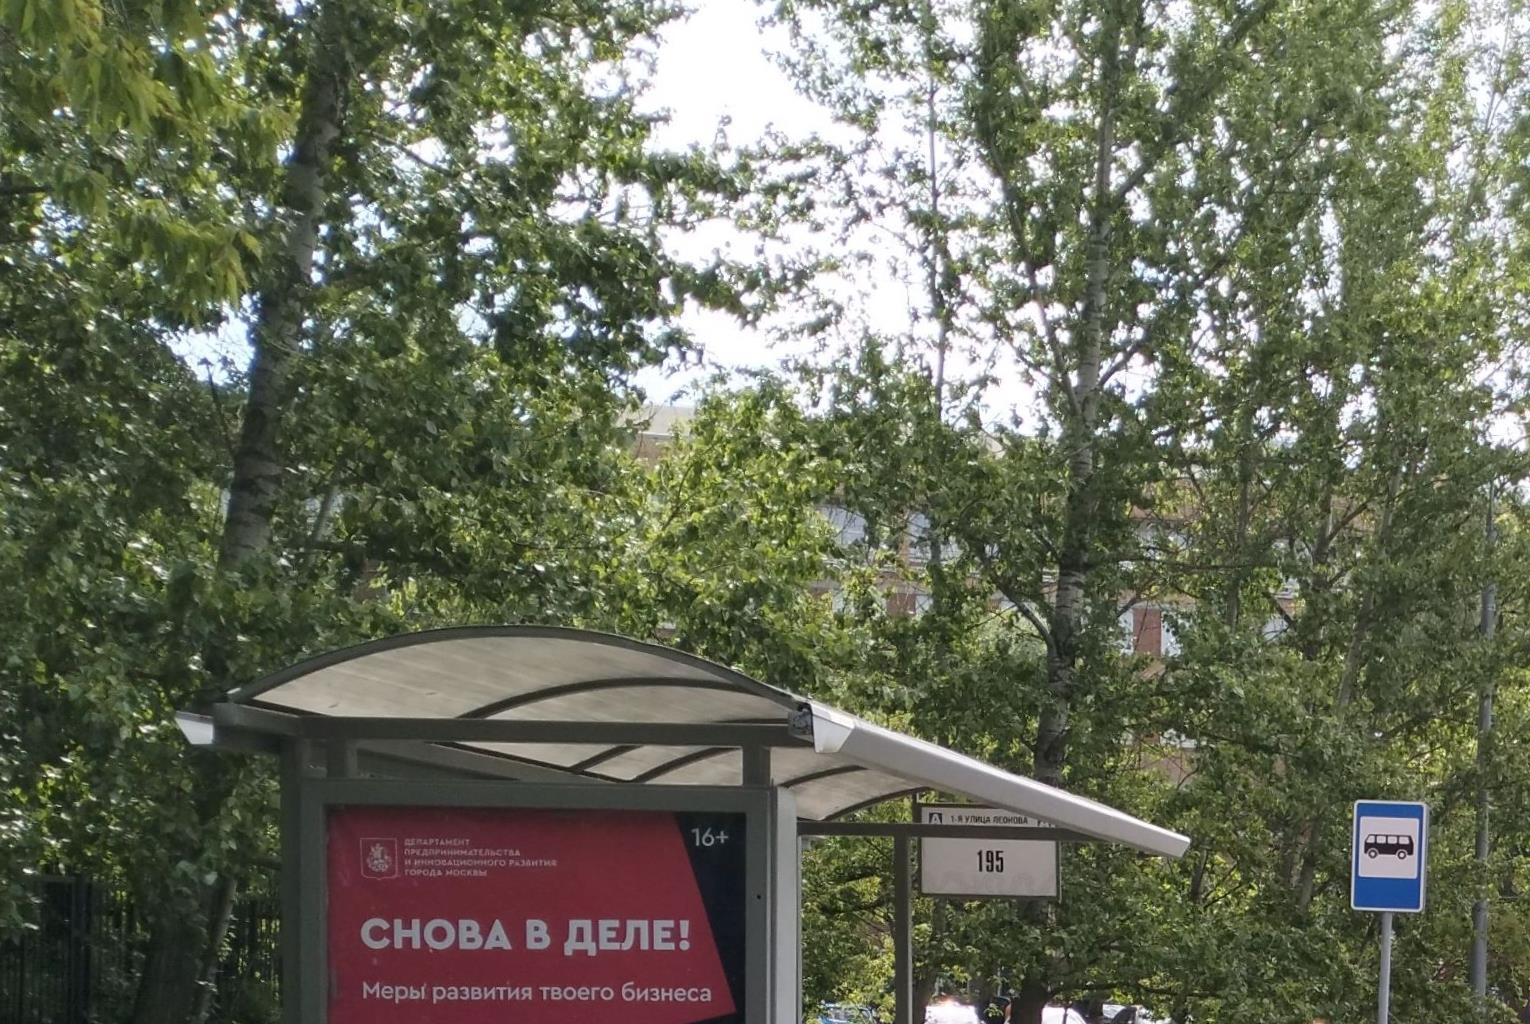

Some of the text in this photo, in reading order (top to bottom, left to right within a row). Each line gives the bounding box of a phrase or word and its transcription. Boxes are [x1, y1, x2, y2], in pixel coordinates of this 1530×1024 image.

[964, 815, 991, 825] УЛИЦА
[691, 827, 729, 847] 16+
[404, 838, 470, 847] ДЕПАРТАМЕНТ
[403, 848, 521, 857] ПРЕДПРИНИМАТЕЛЬСТВА
[404, 858, 557, 867] И ИННОВАЦИОННОГО РАЗВИТИЯ
[976, 849, 1005, 873] 195
[404, 868, 488, 877] ГОРОДА МОСКВЫ
[360, 917, 691, 957] СНОВА В ДЕЛЕ!
[362, 981, 712, 1004] Меры развития твоего бизнеса
